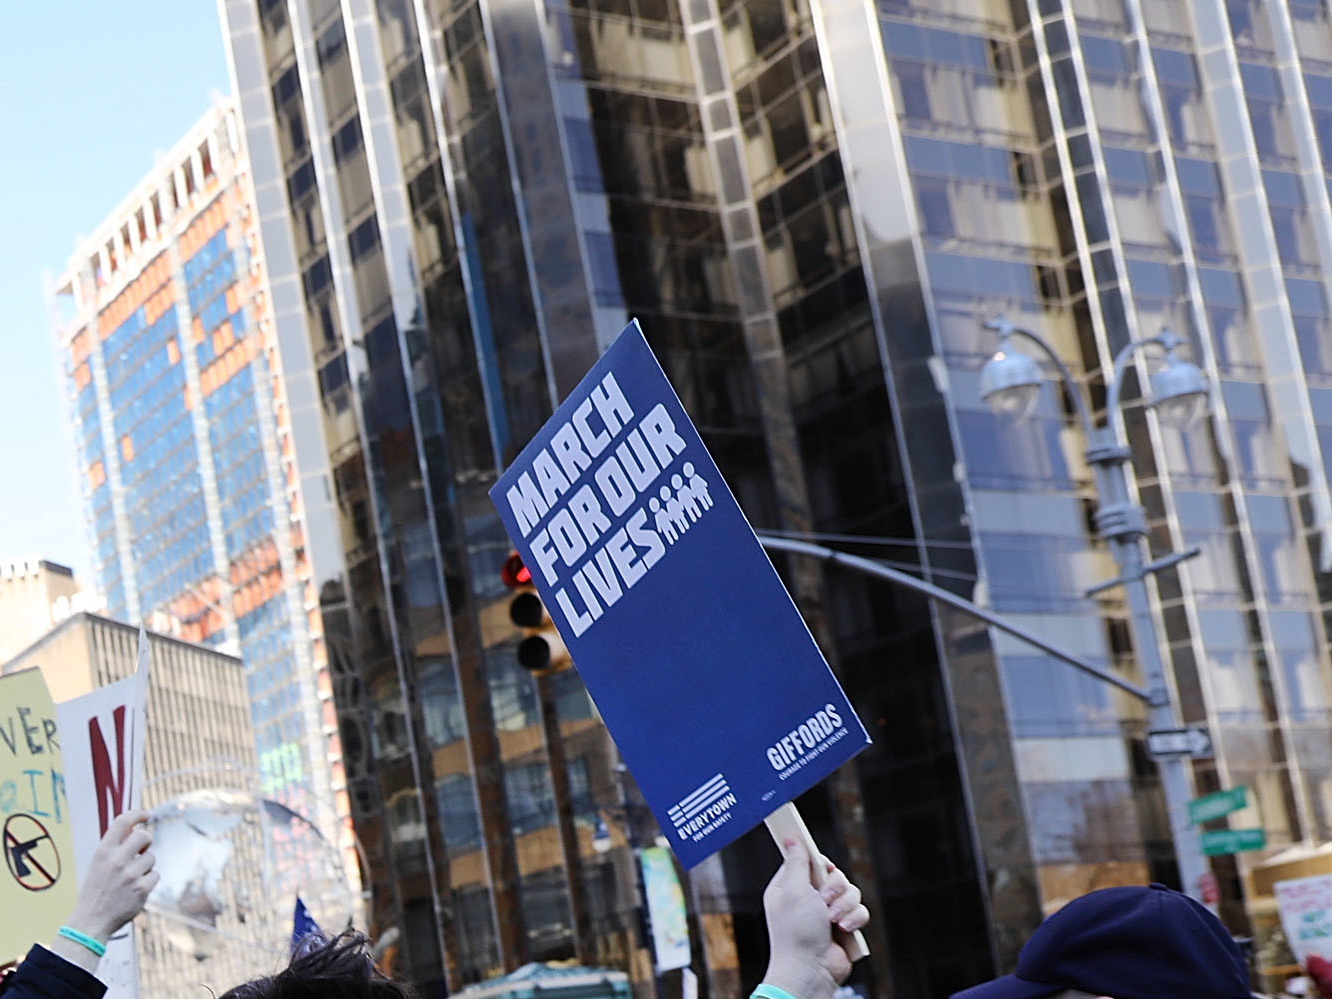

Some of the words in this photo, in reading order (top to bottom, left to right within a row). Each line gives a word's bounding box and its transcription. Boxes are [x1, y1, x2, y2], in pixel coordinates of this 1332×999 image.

[506, 371, 635, 539] MARCH
[529, 484, 612, 588] FOR
[595, 404, 686, 516] OUR
[553, 506, 666, 638] LIVES
[766, 703, 843, 771] GIFFORDS
[677, 793, 738, 841] EVERYTOWN
